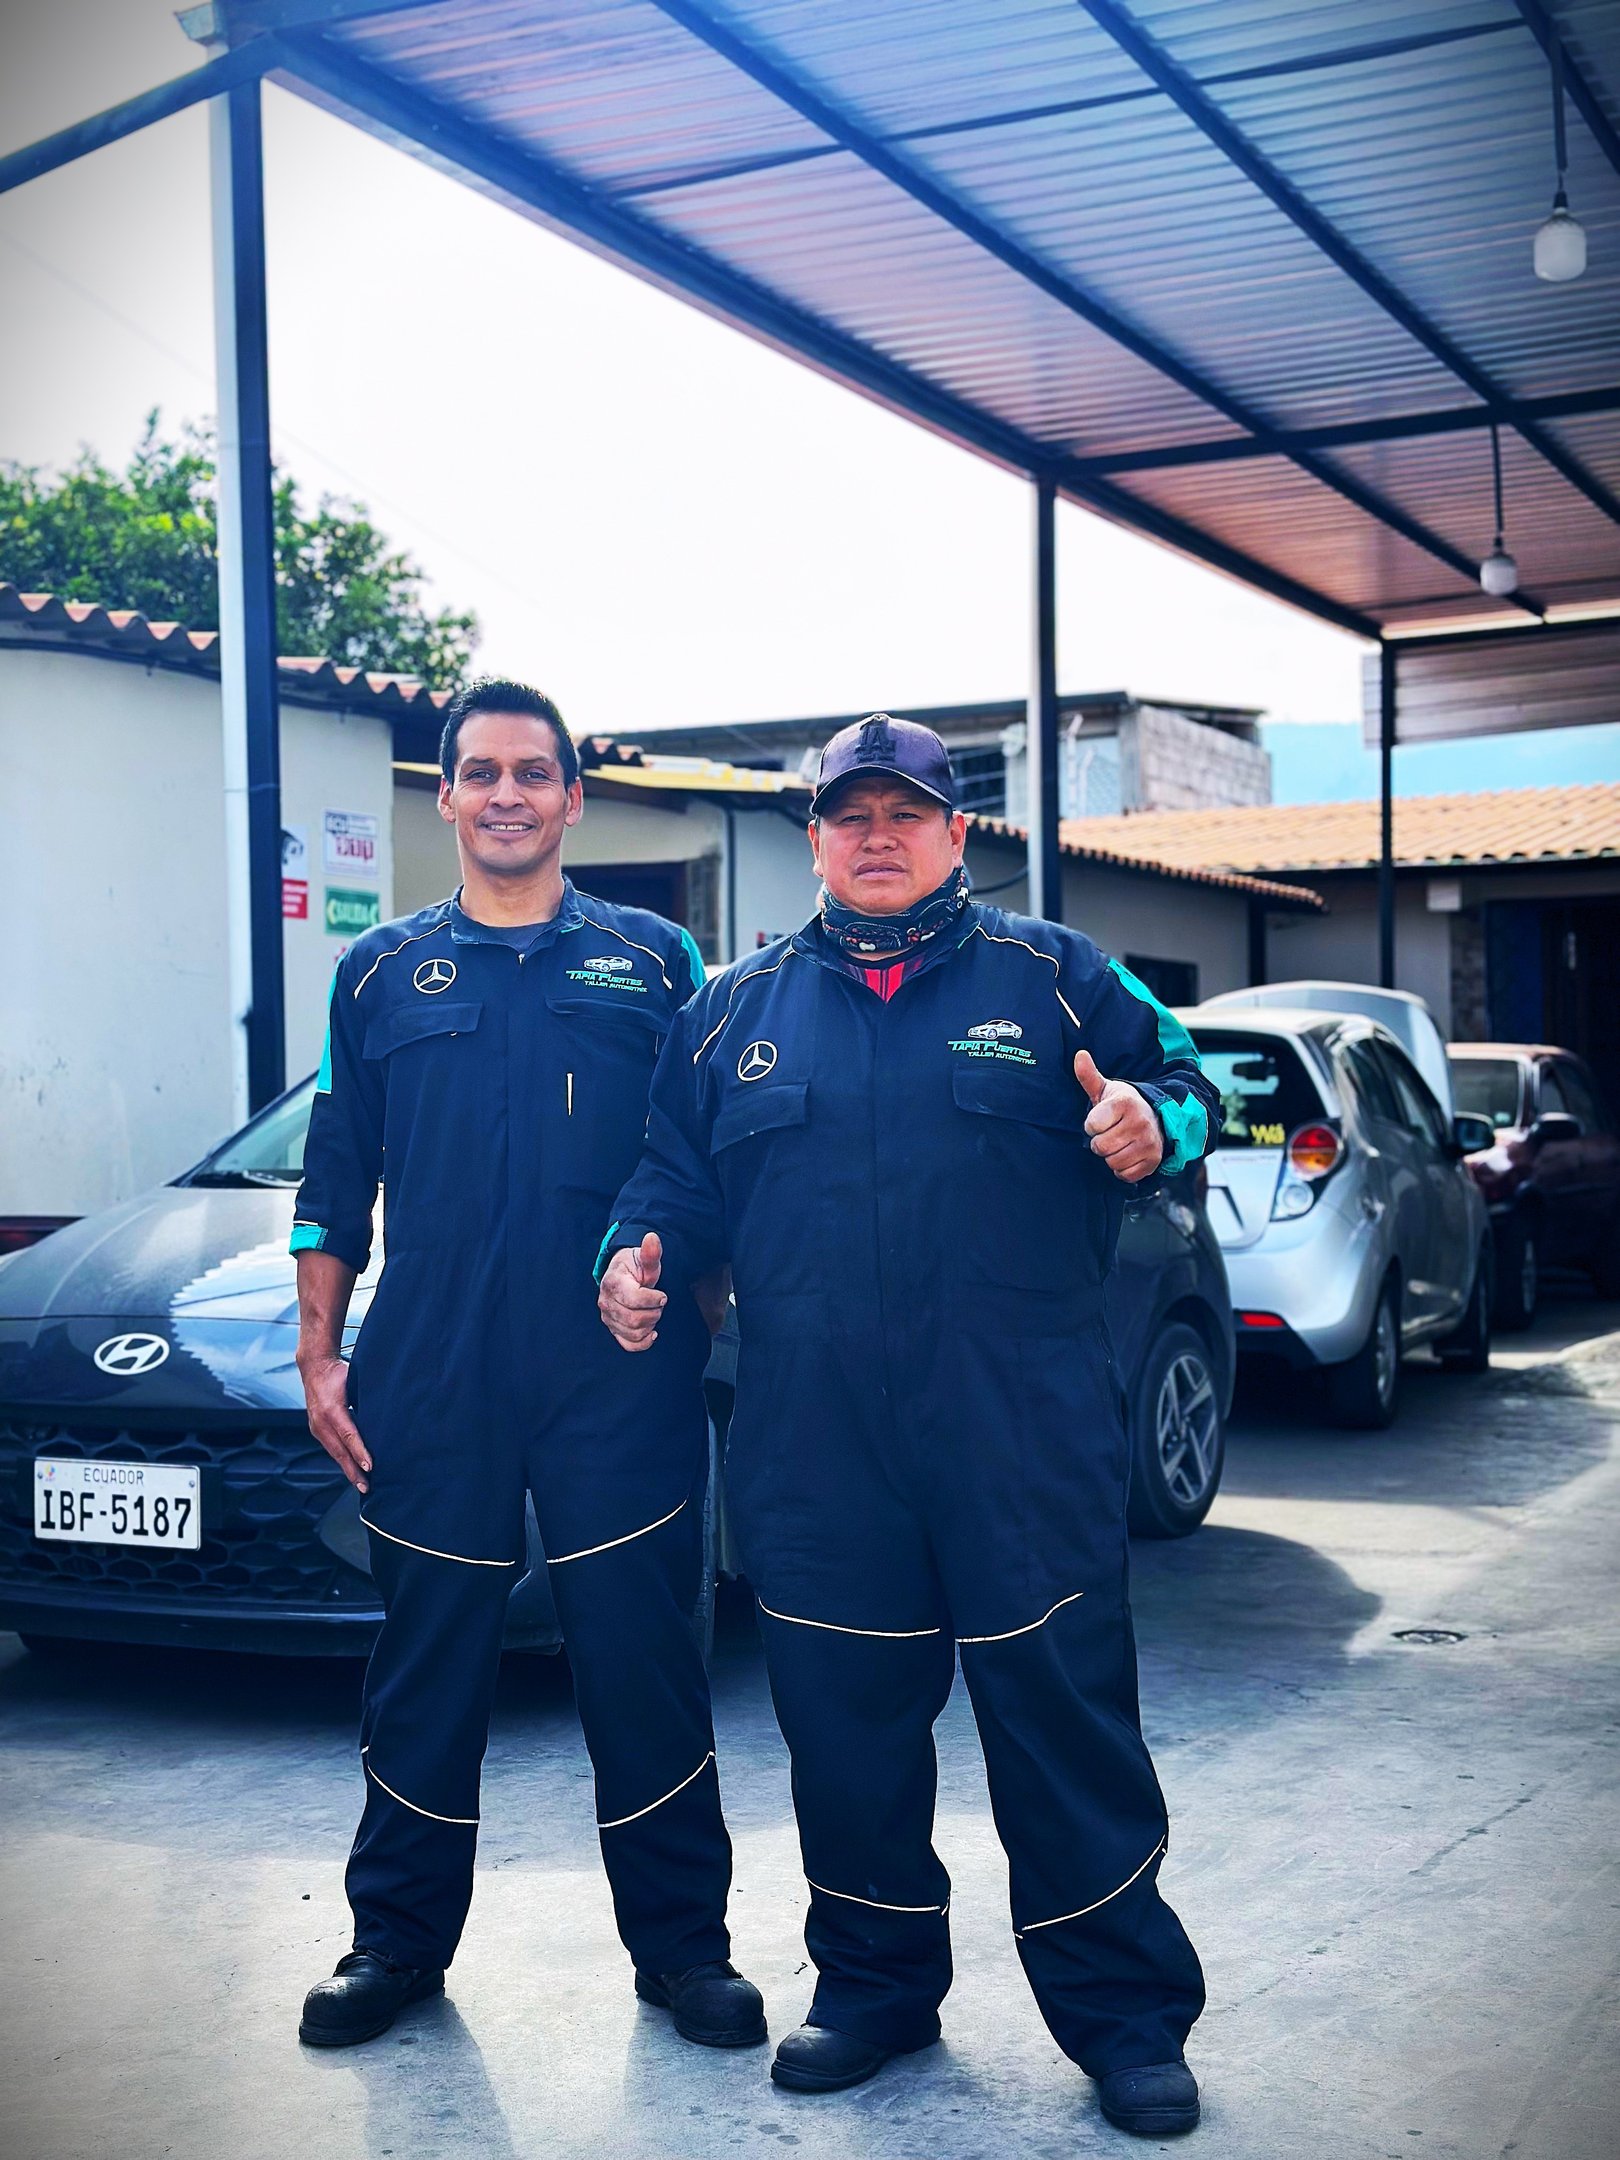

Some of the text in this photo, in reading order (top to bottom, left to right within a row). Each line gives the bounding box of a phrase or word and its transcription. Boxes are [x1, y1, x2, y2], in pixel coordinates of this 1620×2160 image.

[947, 1041, 980, 1051] TAPIA
[84, 1467, 145, 1485] ECUADOR
[41, 1489, 192, 1539] IBF-5187
